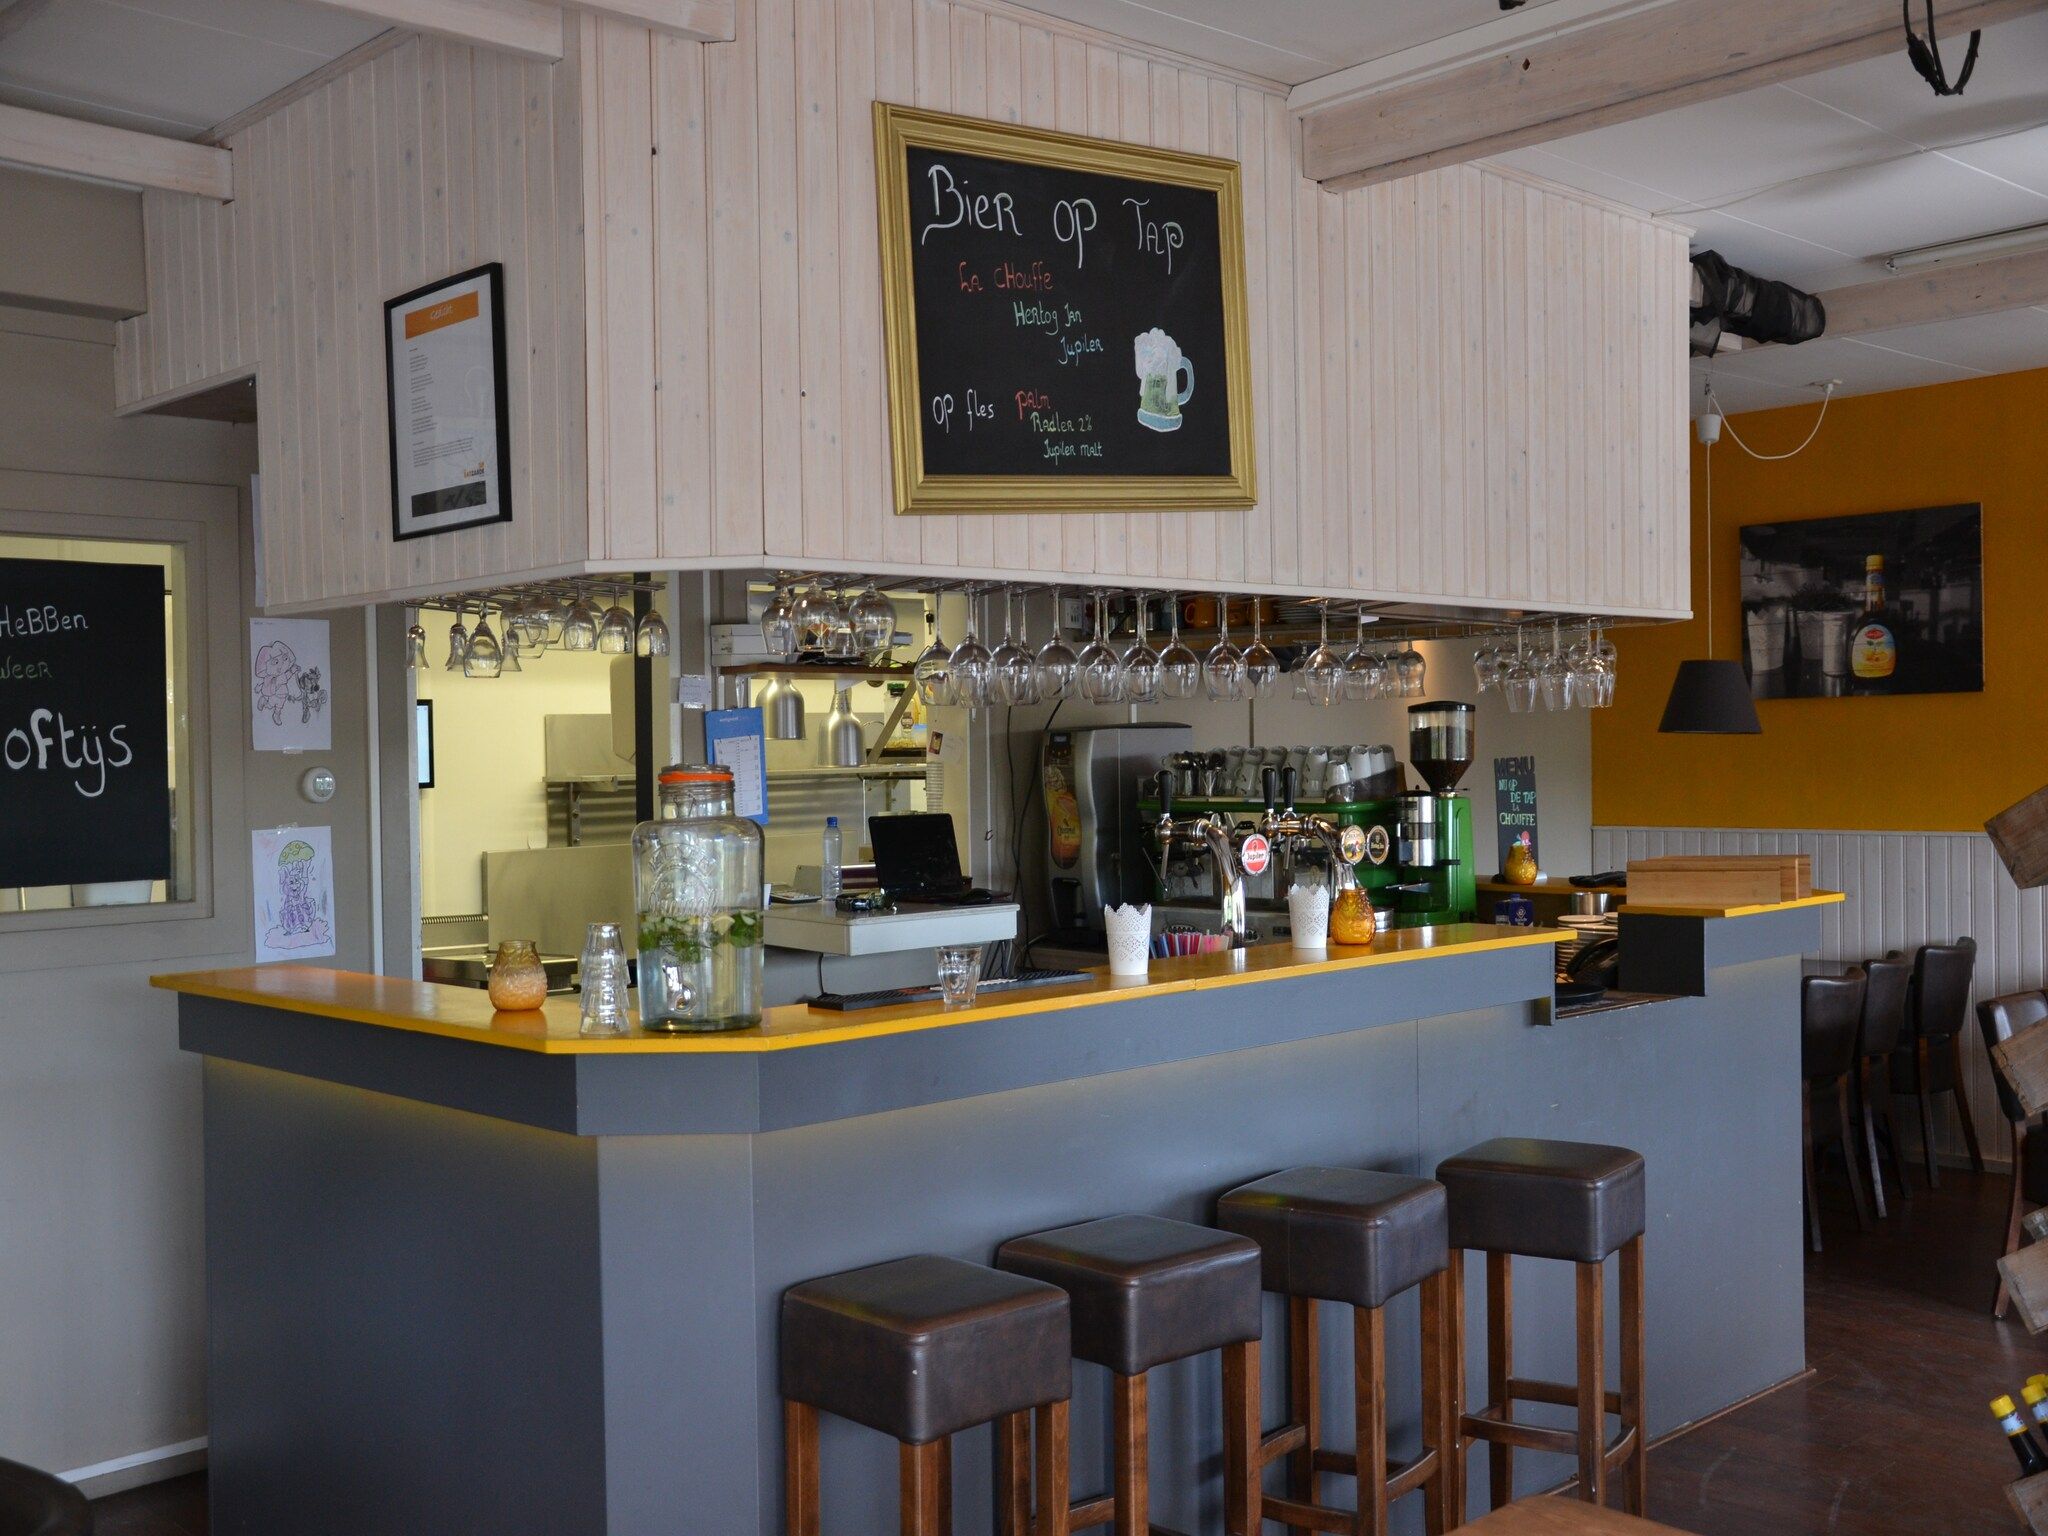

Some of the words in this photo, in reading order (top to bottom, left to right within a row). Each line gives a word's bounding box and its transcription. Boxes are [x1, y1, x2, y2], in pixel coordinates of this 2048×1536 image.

[966, 388, 995, 431] fles
[1078, 414, 1093, 432] 2%
[1493, 755, 1536, 776] MENU
[1510, 791, 1521, 803] DE
[1523, 791, 1537, 804] TAP
[1499, 812, 1536, 826] CHOUFFE
[1246, 850, 1266, 862] Jupiler
